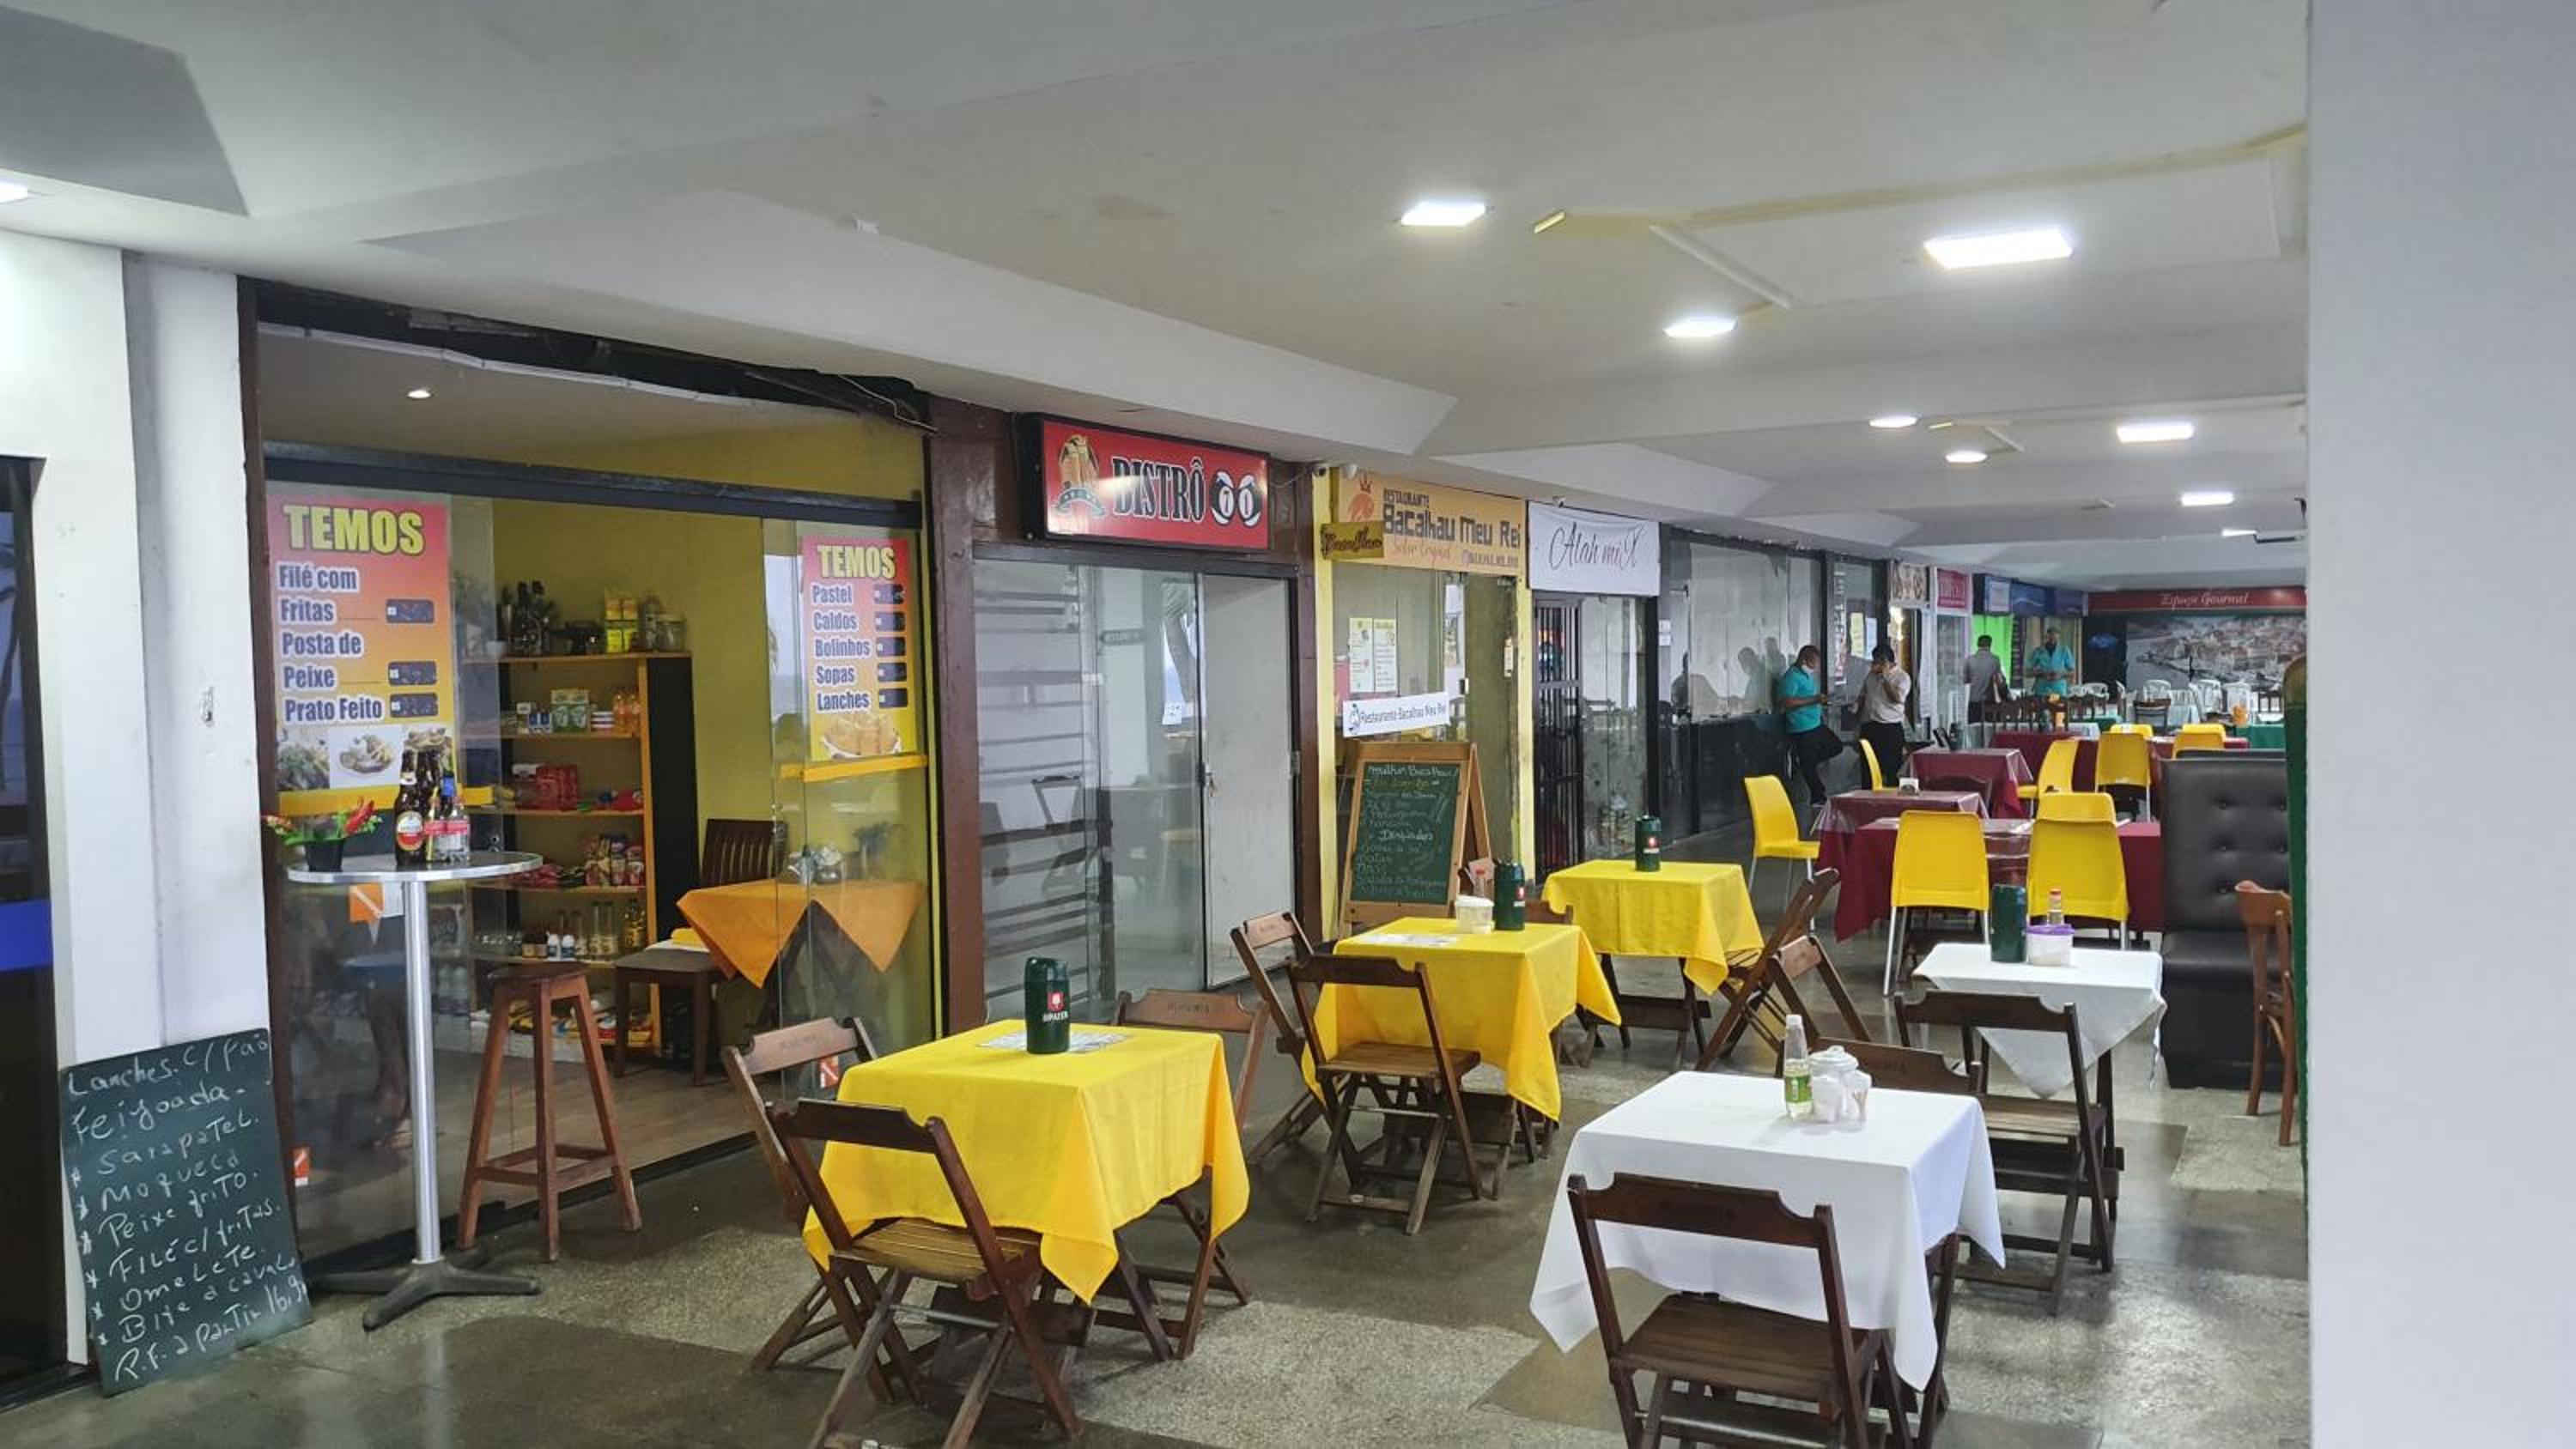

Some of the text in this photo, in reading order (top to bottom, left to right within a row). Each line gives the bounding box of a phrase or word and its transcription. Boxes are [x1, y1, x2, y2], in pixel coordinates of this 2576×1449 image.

[1111, 456, 1205, 523] DISTRÔ
[283, 505, 425, 555] TEMOS
[1383, 503, 1455, 542] Bacalhau
[1500, 519, 1521, 549] Rei
[817, 545, 896, 579] TEMOS
[279, 565, 358, 591] Filé com
[812, 585, 852, 603] Pastel
[280, 599, 335, 622] Fritas
[813, 612, 857, 631] Caldos
[282, 631, 362, 656] Posta de
[815, 639, 870, 658] Bolinhos
[283, 665, 336, 688] Peixe
[816, 665, 854, 685] Sopas
[285, 700, 336, 722] Prato
[339, 697, 383, 719] Feito
[817, 692, 870, 711] Lanches
